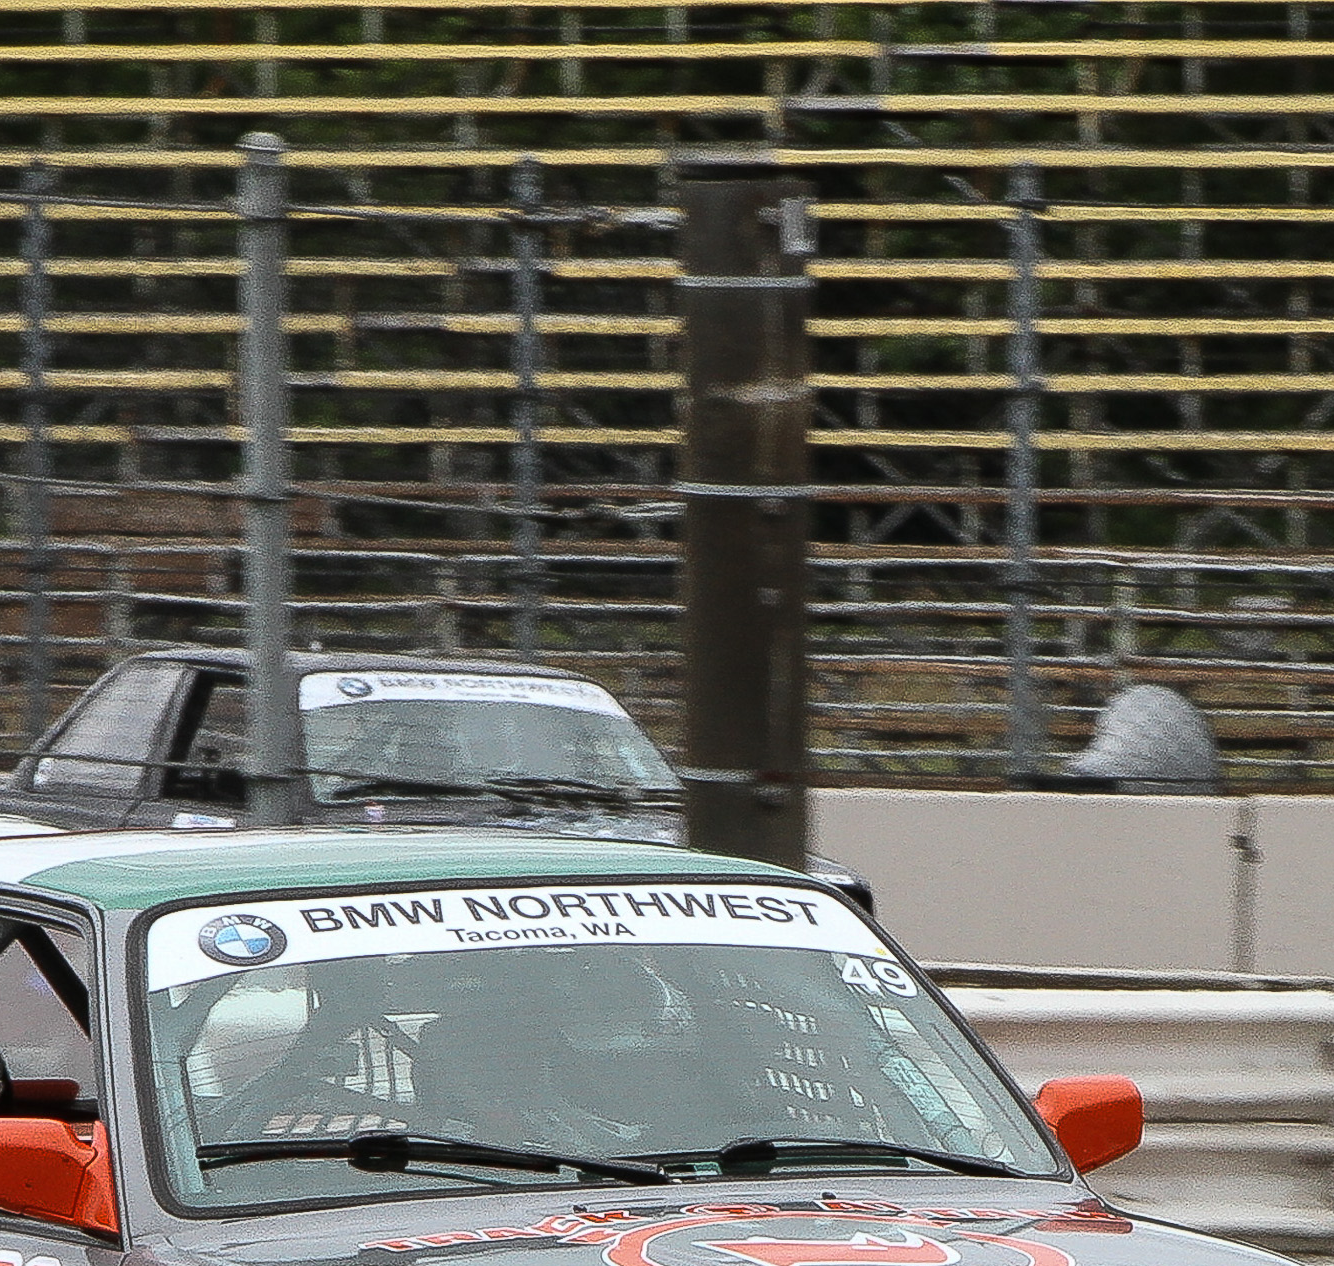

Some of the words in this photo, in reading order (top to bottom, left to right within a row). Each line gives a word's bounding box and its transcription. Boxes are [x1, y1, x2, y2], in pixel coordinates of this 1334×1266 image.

[299, 899, 445, 933] BMW
[462, 893, 820, 926] NORTHWEST
[446, 924, 577, 944] Tacoma,
[583, 922, 637, 938] WA
[841, 956, 918, 999] 49
